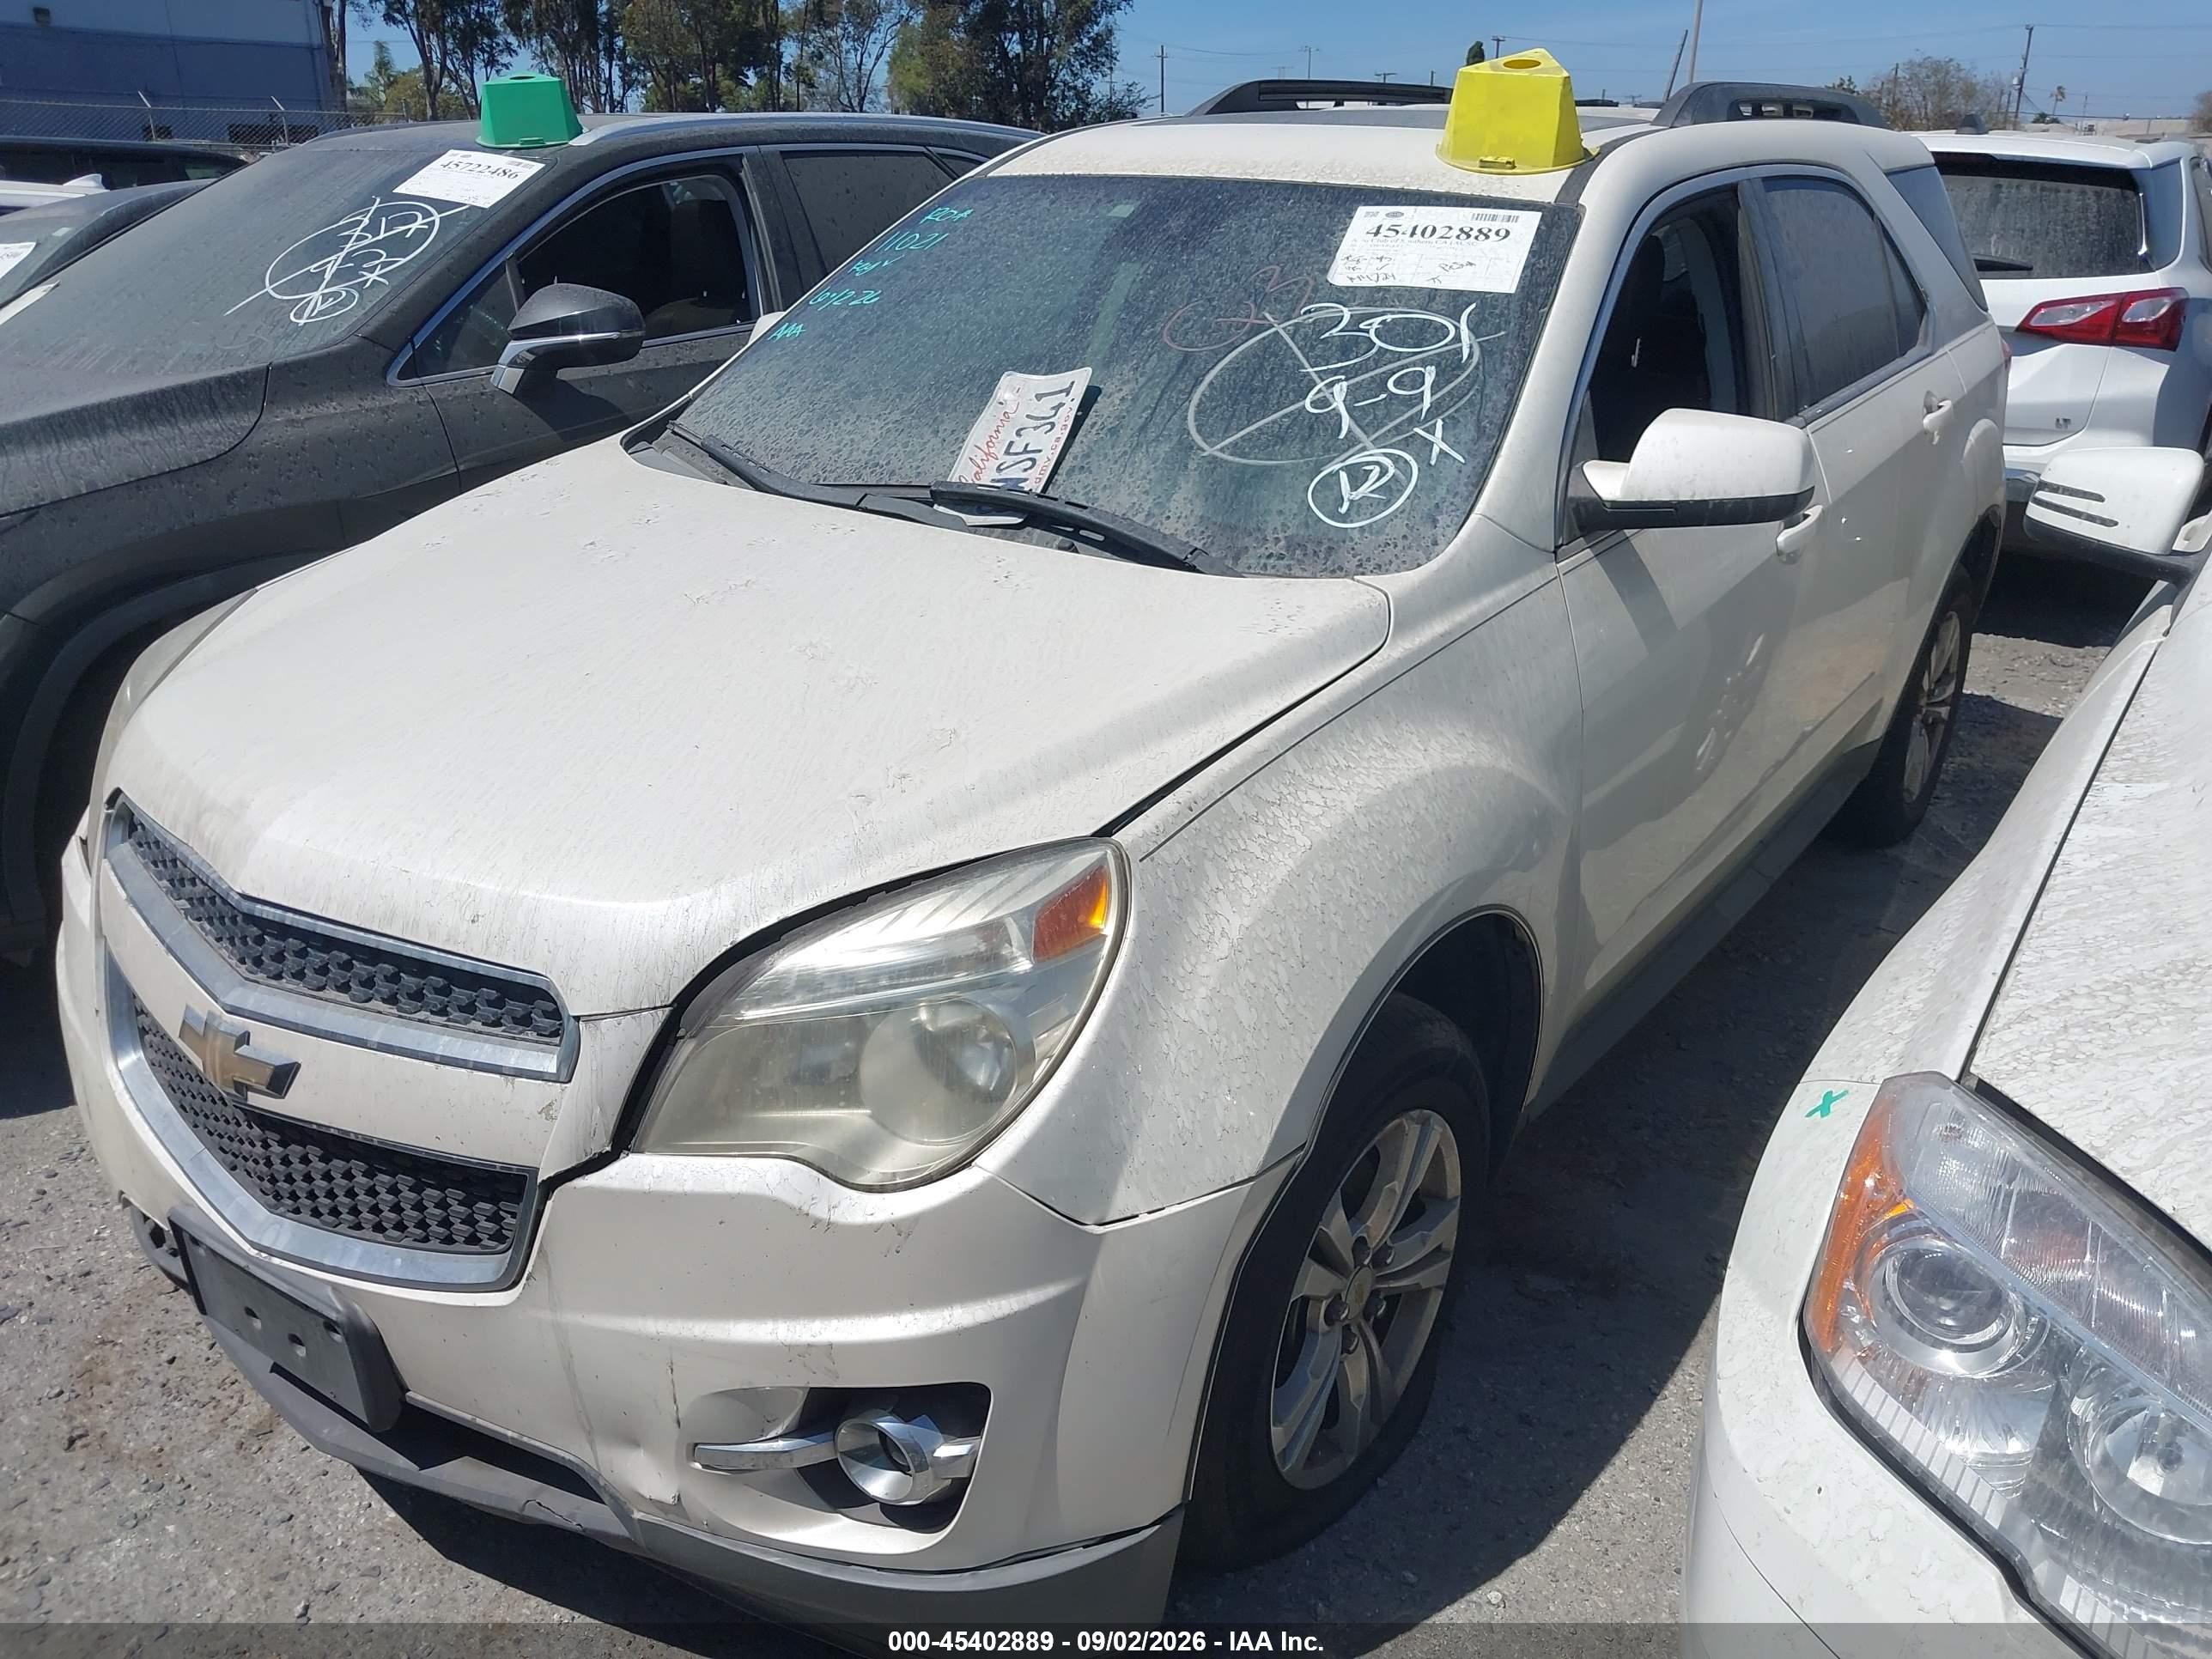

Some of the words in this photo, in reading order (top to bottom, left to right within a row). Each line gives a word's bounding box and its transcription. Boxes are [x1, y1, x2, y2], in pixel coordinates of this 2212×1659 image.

[441, 161, 519, 179] 45722486
[875, 230, 949, 252] 11021
[1366, 223, 1511, 242] 45402889
[1034, 407, 1073, 484] dmv.ca.gov
